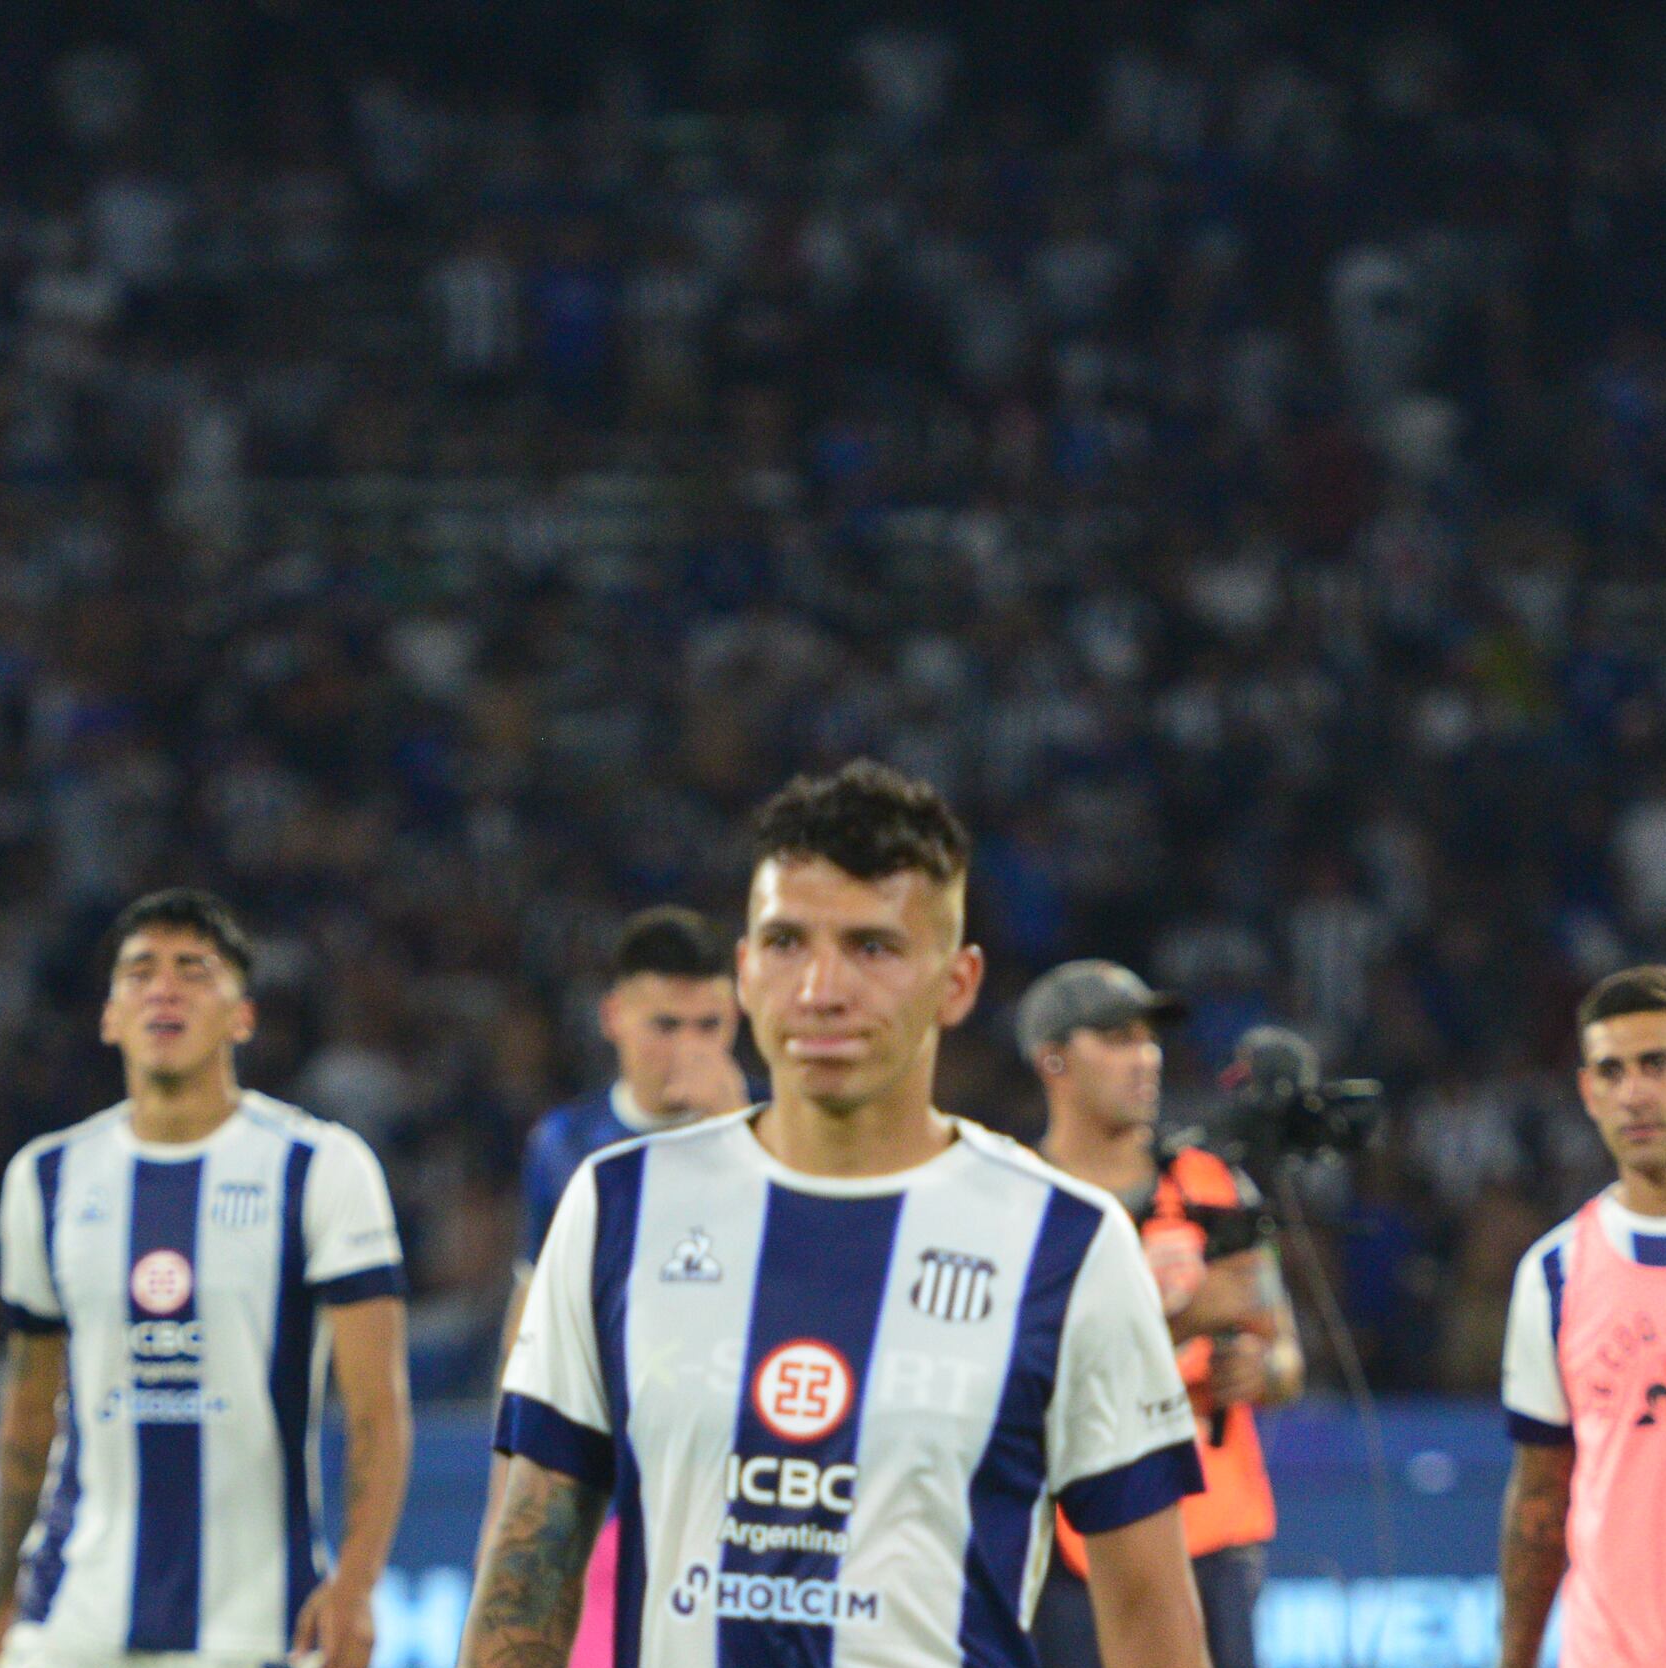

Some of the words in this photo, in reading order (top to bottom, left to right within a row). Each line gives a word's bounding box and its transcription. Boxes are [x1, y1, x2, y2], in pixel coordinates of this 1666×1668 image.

[726, 1453, 859, 1514] ICBC
[717, 1515, 849, 1555] Argentina
[715, 1579, 879, 1620] HOLCIM
